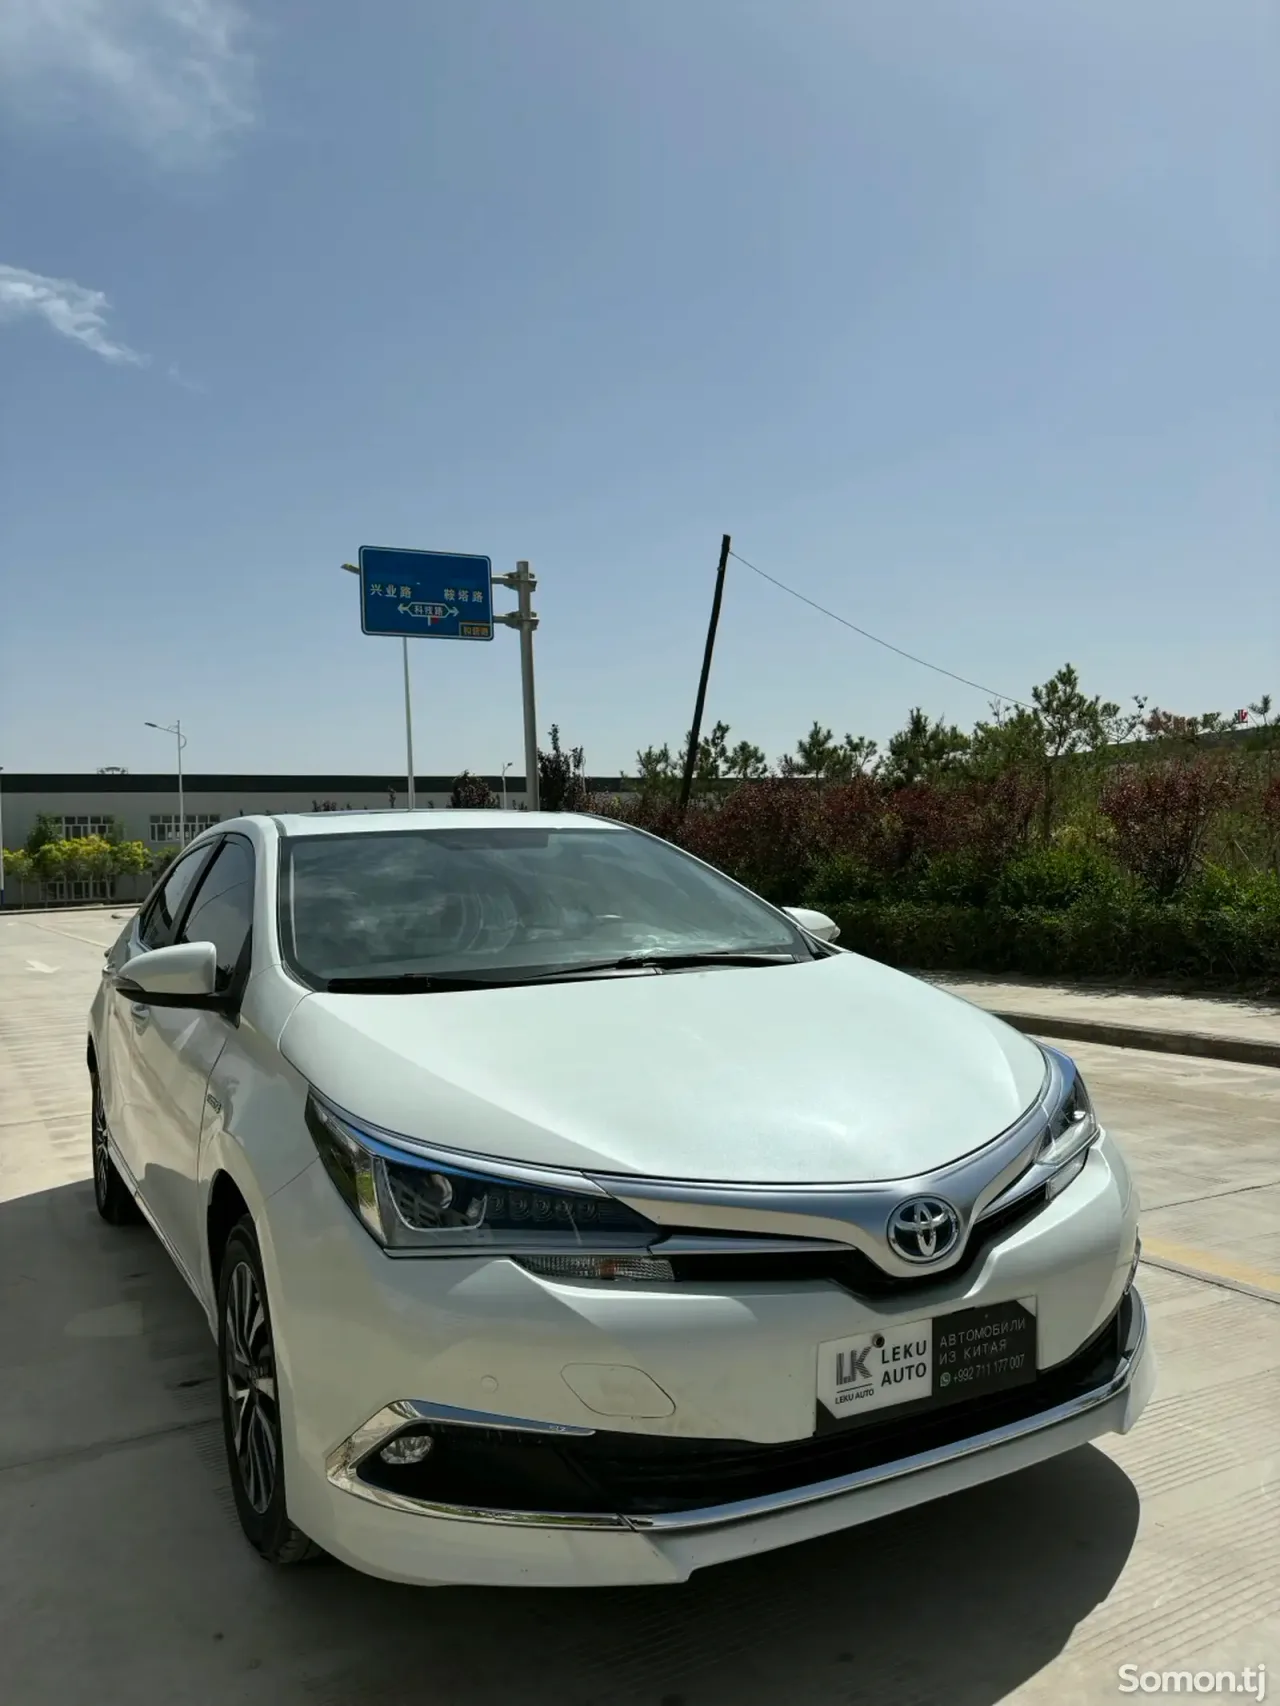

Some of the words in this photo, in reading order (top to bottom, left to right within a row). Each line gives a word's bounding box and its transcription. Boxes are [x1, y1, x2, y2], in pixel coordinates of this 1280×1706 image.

[370, 583, 412, 598] 兴业路
[940, 1317, 1026, 1348] АВТОМОБИЛИ
[881, 1340, 927, 1365] LEKU
[940, 1351, 956, 1365] ИЗ
[964, 1339, 1007, 1360] КИТАЯ
[881, 1362, 927, 1387] AUTO
[953, 1366, 974, 1383] +992
[976, 1362, 991, 1377] 711
[994, 1358, 1008, 1373] 177
[835, 1393, 854, 1405] LEKU
[855, 1388, 875, 1400] AUTO
